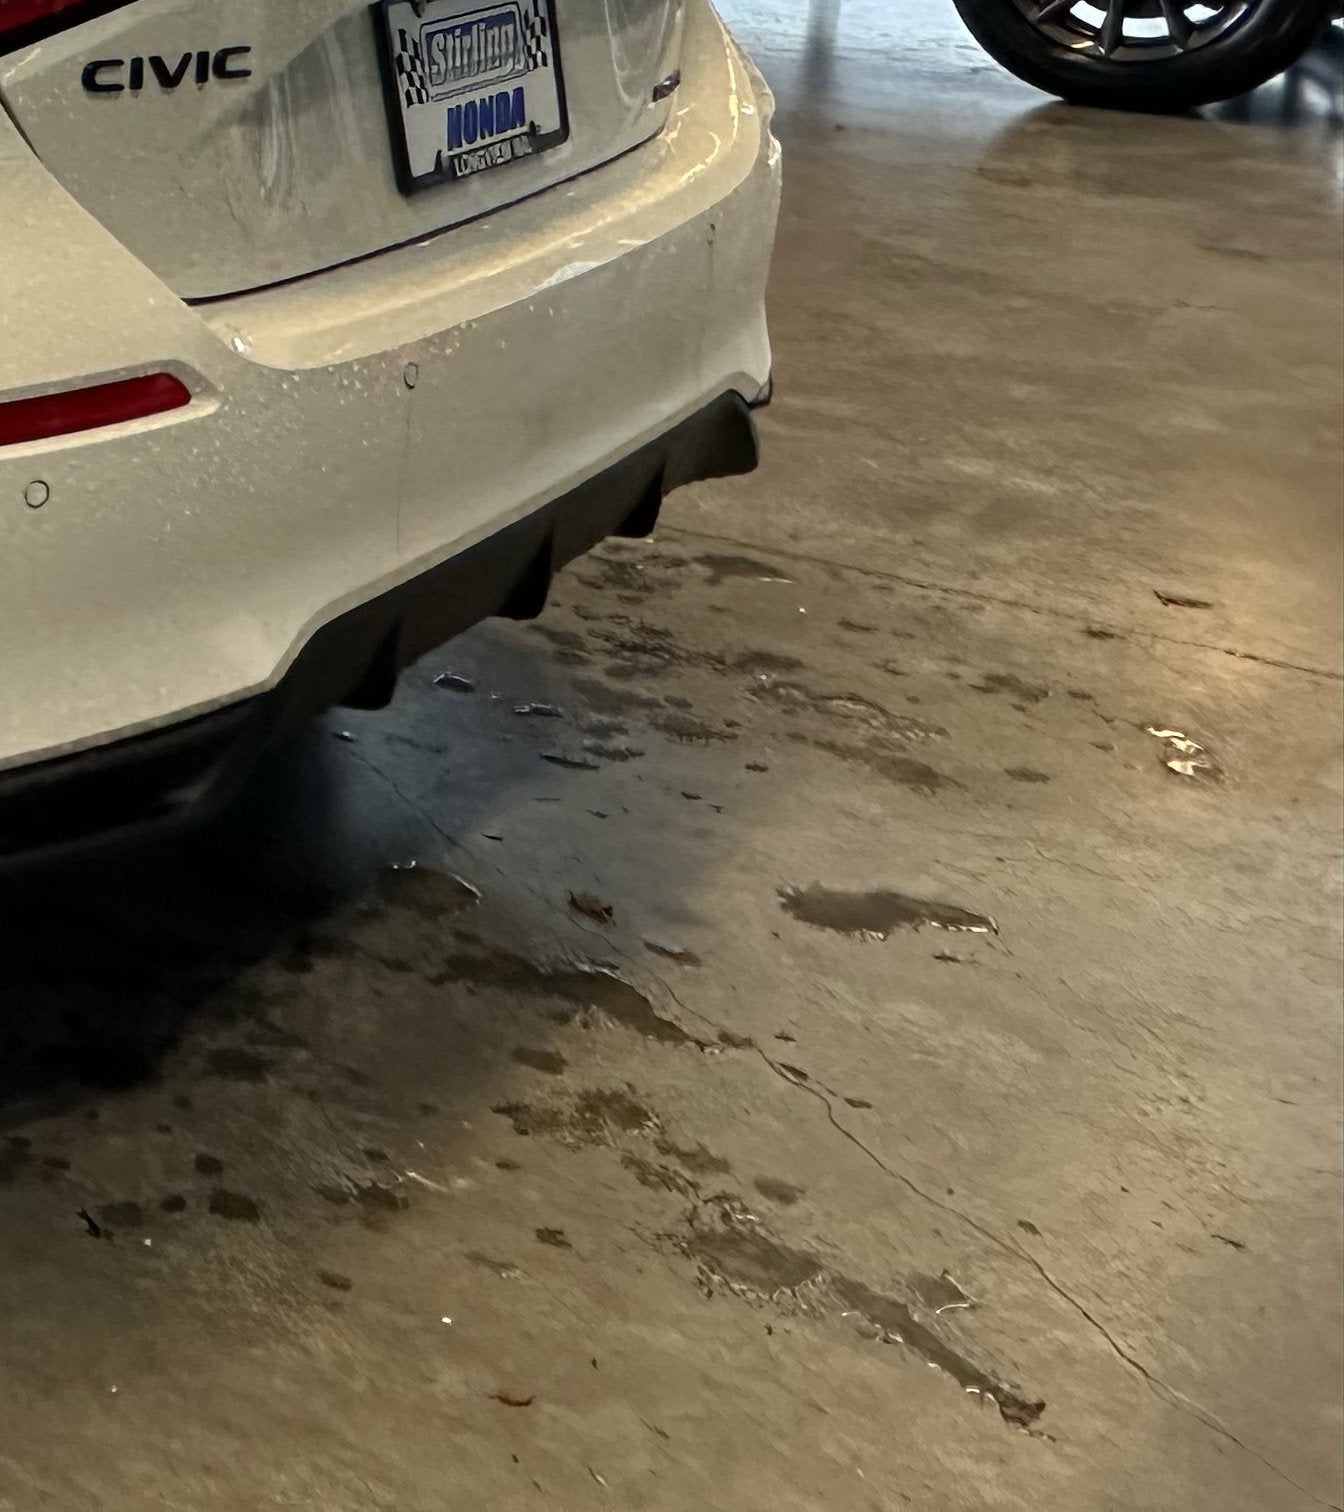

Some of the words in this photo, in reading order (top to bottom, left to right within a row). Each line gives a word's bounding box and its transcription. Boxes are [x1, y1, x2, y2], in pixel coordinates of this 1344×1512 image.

[81, 46, 252, 92] CIVIC
[428, 21, 519, 88] Stirling
[447, 86, 526, 152] HONDA
